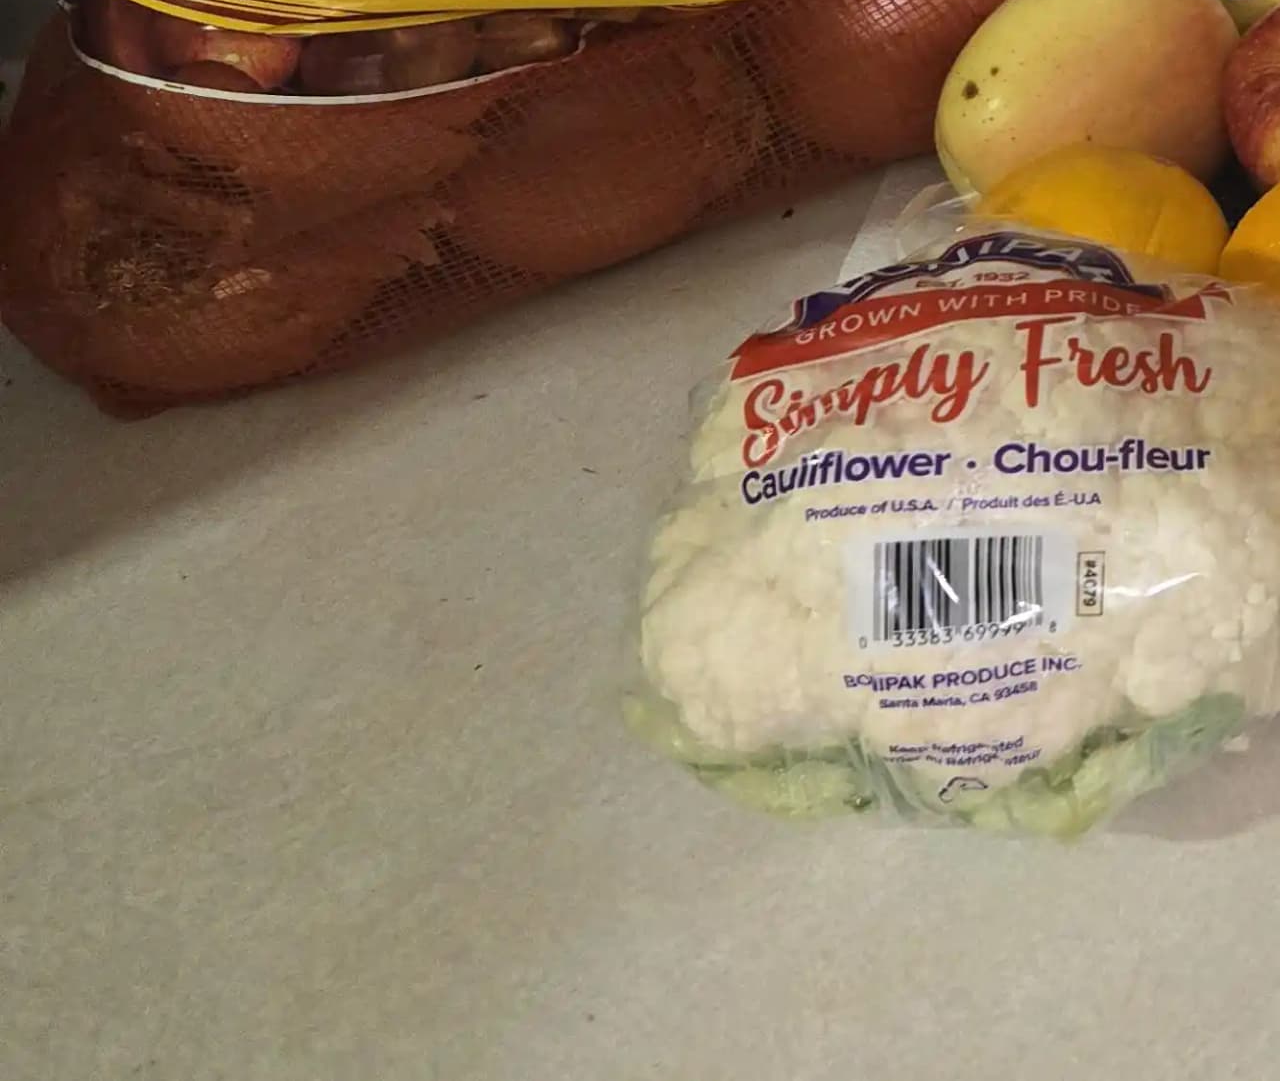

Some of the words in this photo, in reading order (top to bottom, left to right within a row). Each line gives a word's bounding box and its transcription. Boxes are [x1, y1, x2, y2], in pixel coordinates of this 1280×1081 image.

[974, 271, 1030, 283] 1932
[794, 302, 922, 345] GROWN
[938, 291, 1028, 314] WITH
[1044, 289, 1142, 316] PRIDE
[741, 341, 989, 469] Simply
[1014, 317, 1212, 409] Fresh
[741, 449, 952, 505] Cauliflower
[993, 439, 1212, 475] Chou-fleur
[805, 507, 868, 521] Produce
[872, 502, 888, 514] of
[962, 496, 1019, 509] Produit
[1023, 495, 1050, 507] des
[932, 659, 1036, 688] PRODUCE
[1041, 657, 1083, 671] INC.
[969, 692, 991, 703] CA
